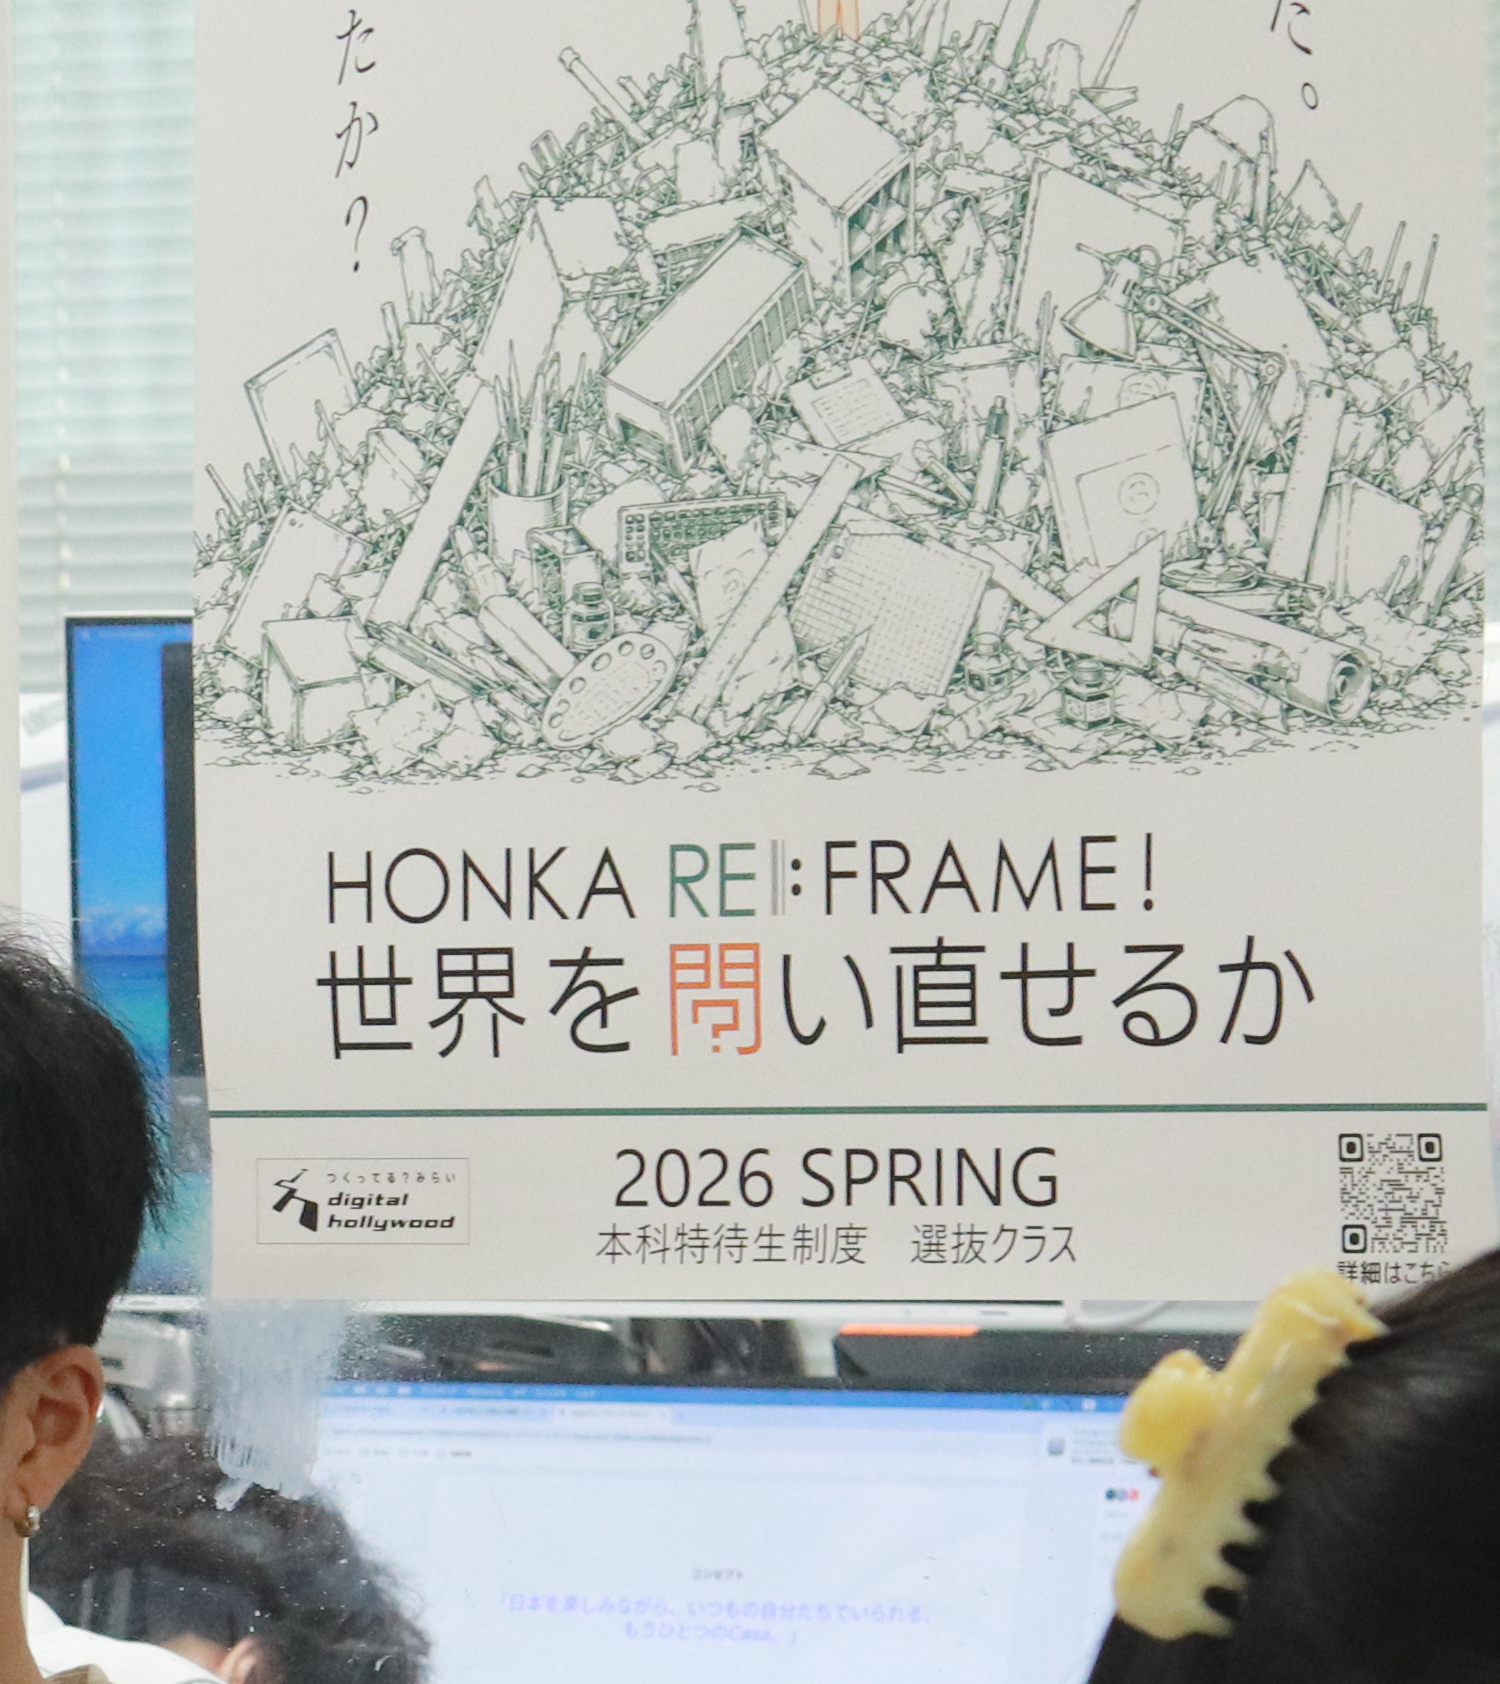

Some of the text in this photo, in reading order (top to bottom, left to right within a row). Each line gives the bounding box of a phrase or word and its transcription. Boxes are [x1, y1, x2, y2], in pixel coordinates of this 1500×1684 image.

[327, 843, 637, 925] HONKA
[316, 934, 1316, 1060] 世界を問い直せるか
[327, 1191, 410, 1210] digital
[614, 1146, 1059, 1209] 2026 SPRING
[326, 1213, 457, 1232] hollywood
[596, 1222, 1078, 1266] 本科特待生制度 選抜クラス
